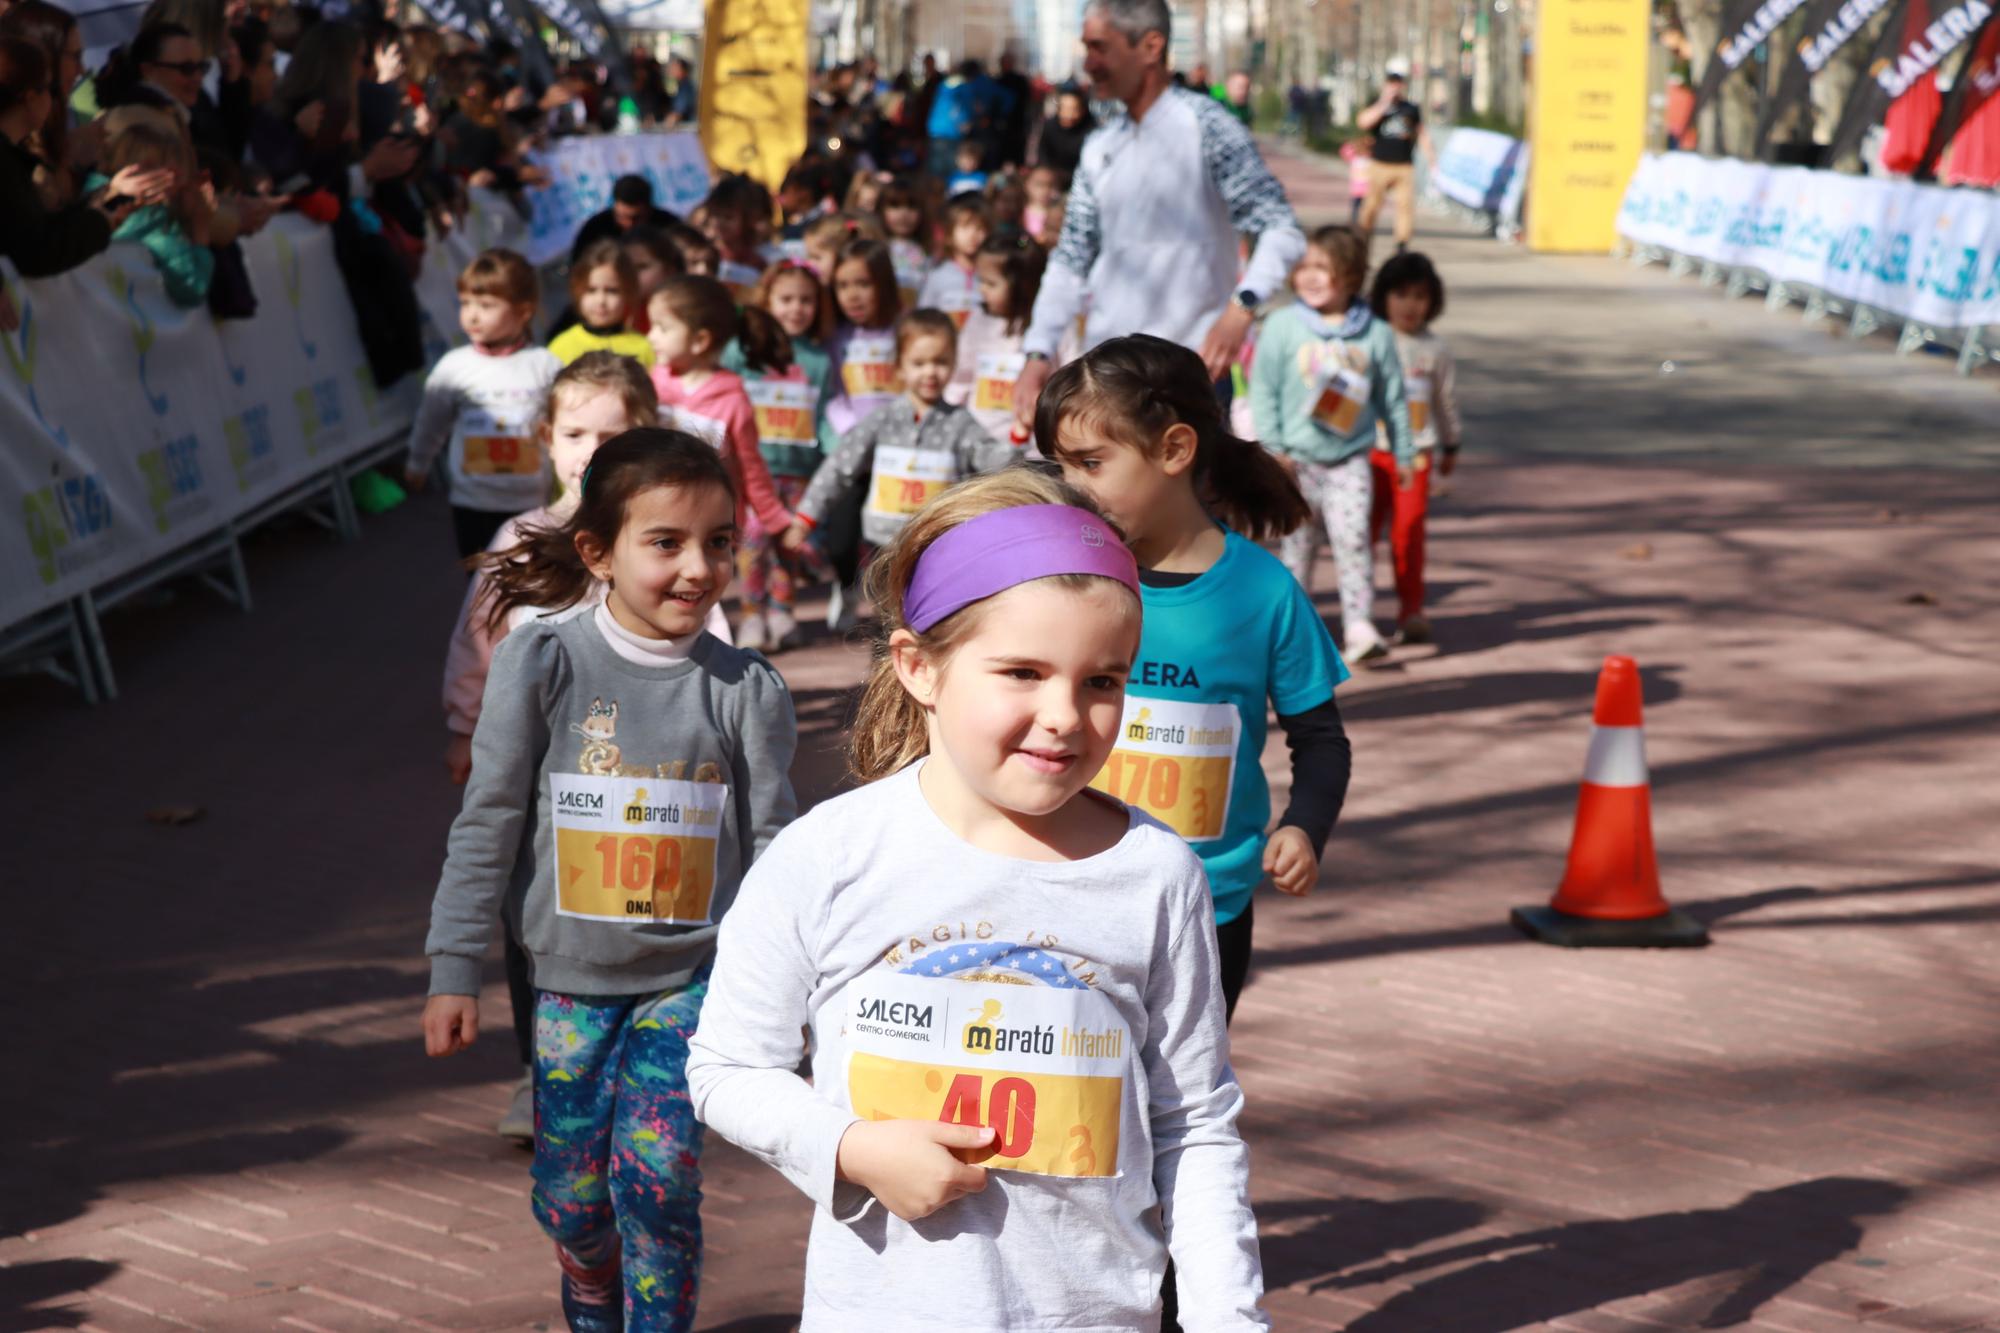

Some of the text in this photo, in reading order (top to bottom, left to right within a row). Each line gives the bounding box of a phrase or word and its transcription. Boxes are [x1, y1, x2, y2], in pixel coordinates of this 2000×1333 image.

[1877, 0, 1993, 98] SALERA
[1128, 722, 1185, 744] marató
[1105, 751, 1181, 810] 170
[557, 790, 604, 809] SALERA
[626, 803, 680, 823] marató
[595, 835, 682, 892] 160
[625, 899, 653, 915] ONA
[883, 920, 994, 968] MAGIC
[856, 997, 933, 1029] SALERA
[856, 1023, 931, 1043] CENTRO COMERCIAL
[966, 1024, 1124, 1060] marató Infantil
[938, 1073, 1037, 1159] 40
